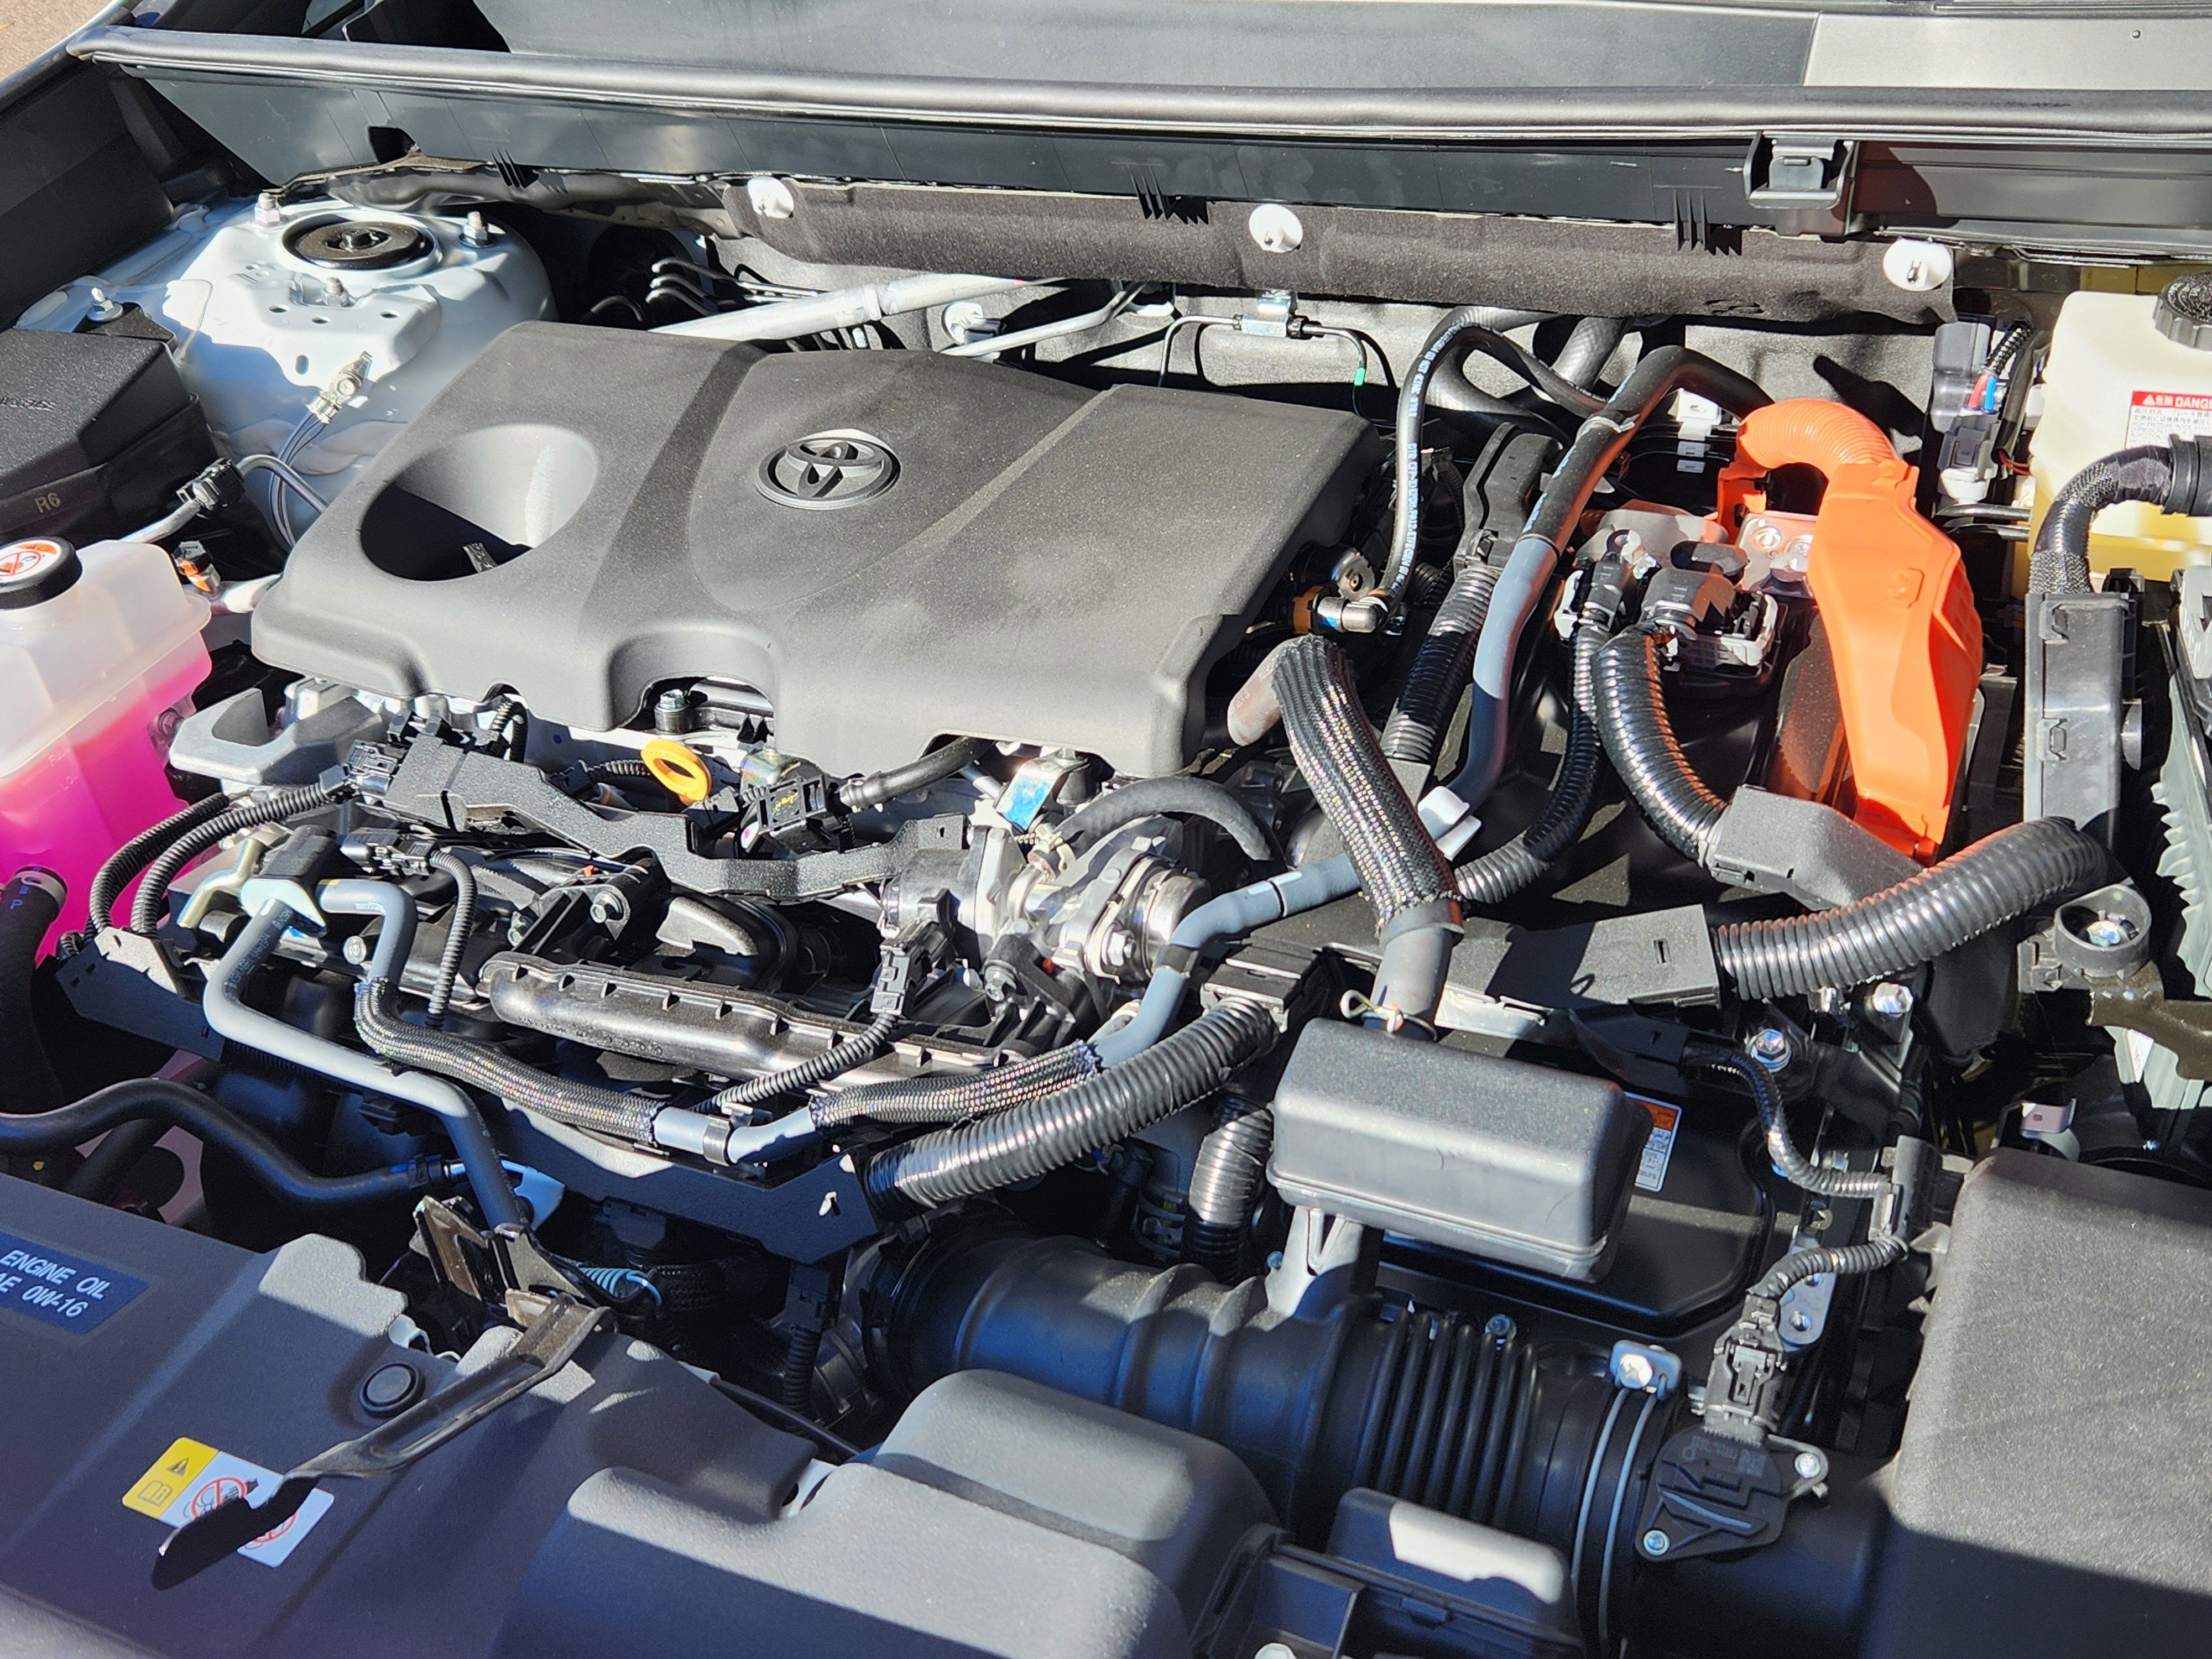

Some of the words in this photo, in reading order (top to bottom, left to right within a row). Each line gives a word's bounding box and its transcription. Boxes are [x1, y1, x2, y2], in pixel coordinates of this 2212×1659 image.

[34, 492, 61, 513] R6
[0, 1250, 77, 1285] ENGINE
[76, 1277, 111, 1300] OIL
[22, 1286, 88, 1317] 0W-16
